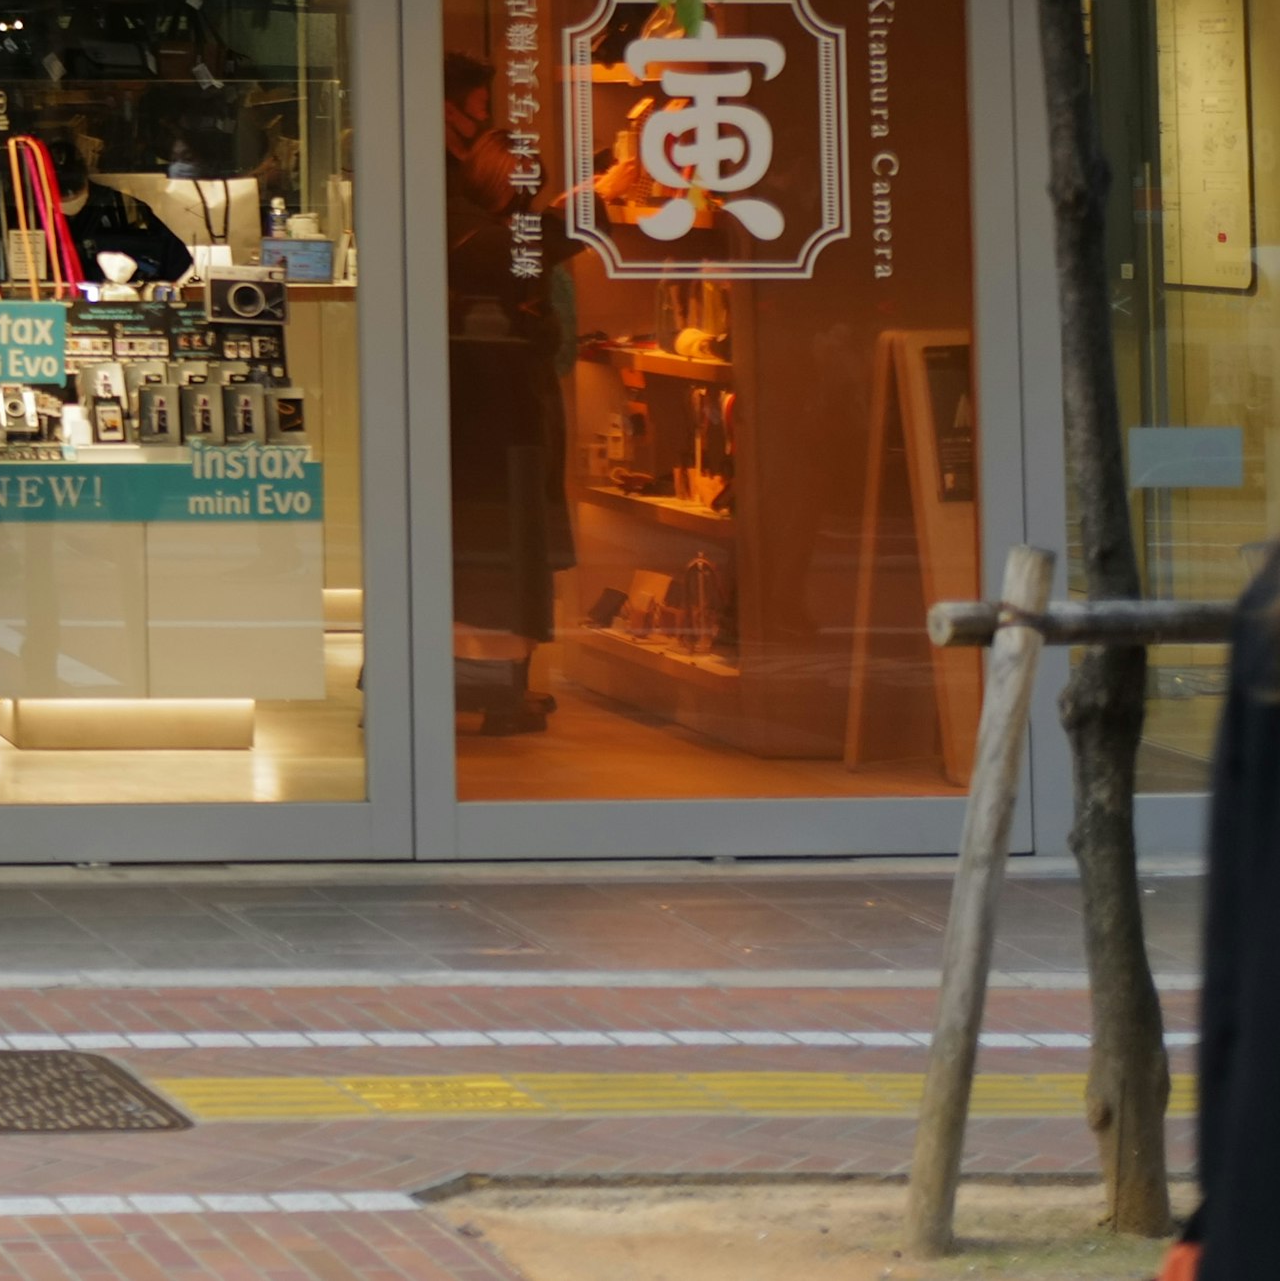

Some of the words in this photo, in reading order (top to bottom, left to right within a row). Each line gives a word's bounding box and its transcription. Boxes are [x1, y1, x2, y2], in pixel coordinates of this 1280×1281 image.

[872, 150, 899, 278] Camera
[510, 210, 543, 278] 新宿
[8, 348, 59, 377] Evo
[192, 441, 308, 479] instax
[189, 491, 251, 515] mini
[257, 484, 313, 515] Evo
